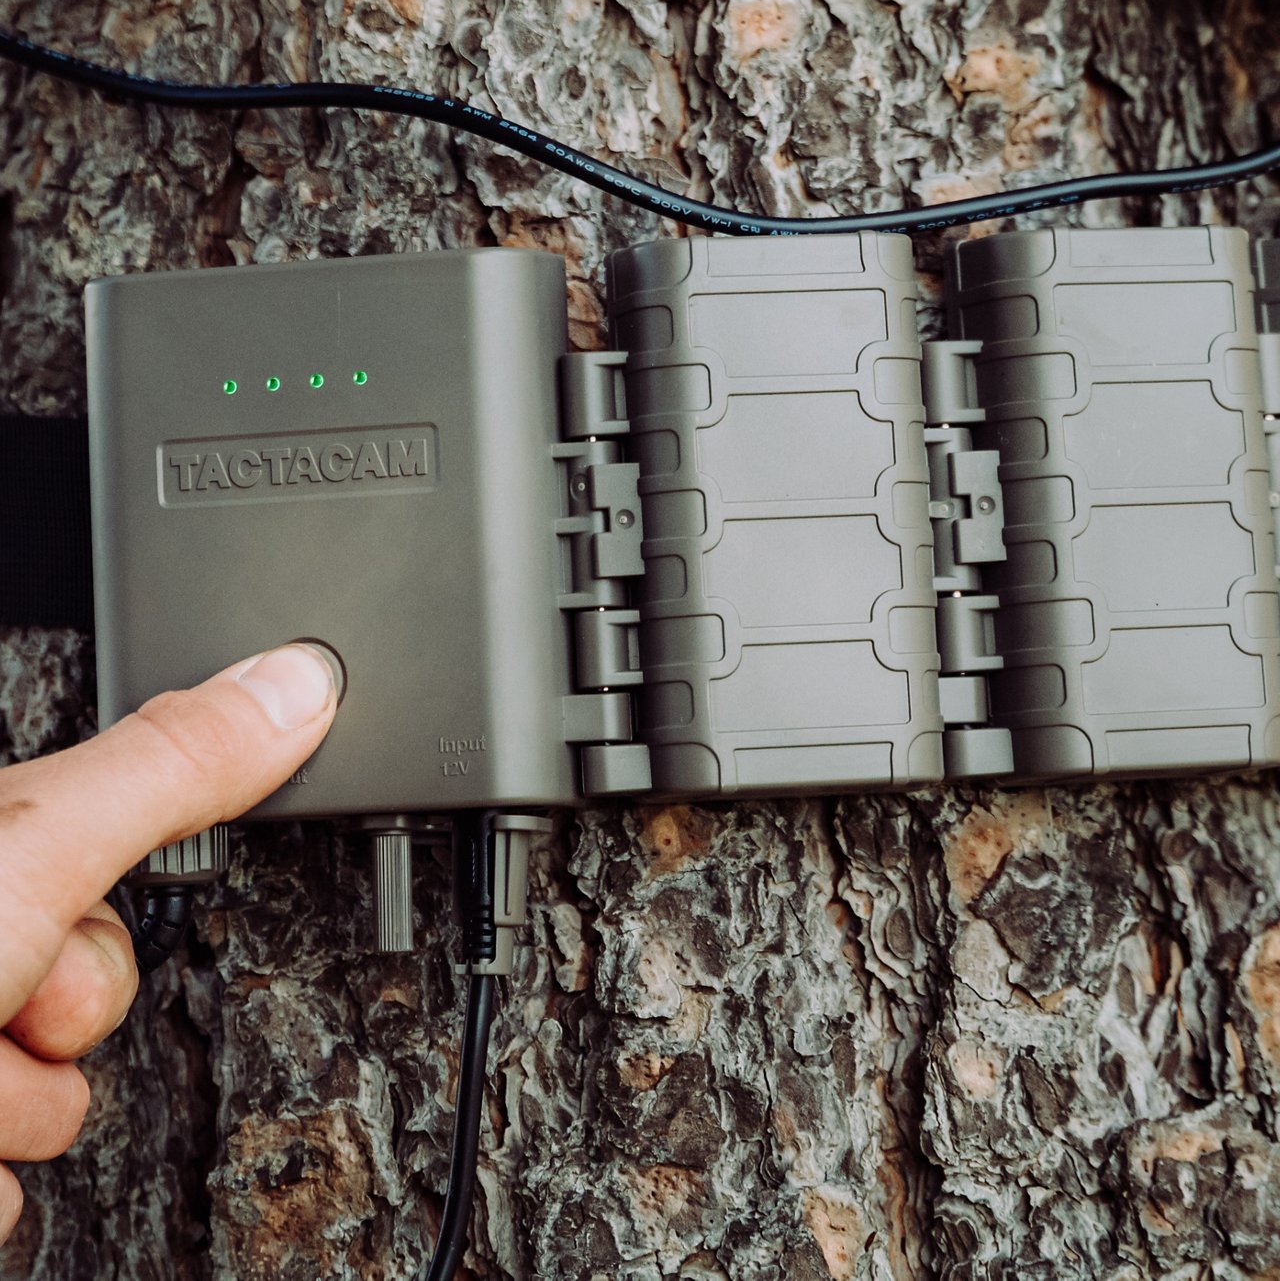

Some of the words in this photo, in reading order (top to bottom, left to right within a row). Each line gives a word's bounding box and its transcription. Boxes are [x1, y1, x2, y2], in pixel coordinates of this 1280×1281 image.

[463, 106, 493, 121] AWM
[499, 120, 538, 142] 2464
[545, 143, 596, 173] 20AWG
[650, 196, 692, 215] 300V
[701, 214, 733, 228] VW-1
[917, 219, 957, 231] 300V
[170, 438, 428, 492] TACTACAM
[439, 735, 487, 756] Input
[440, 760, 470, 776] 12V
